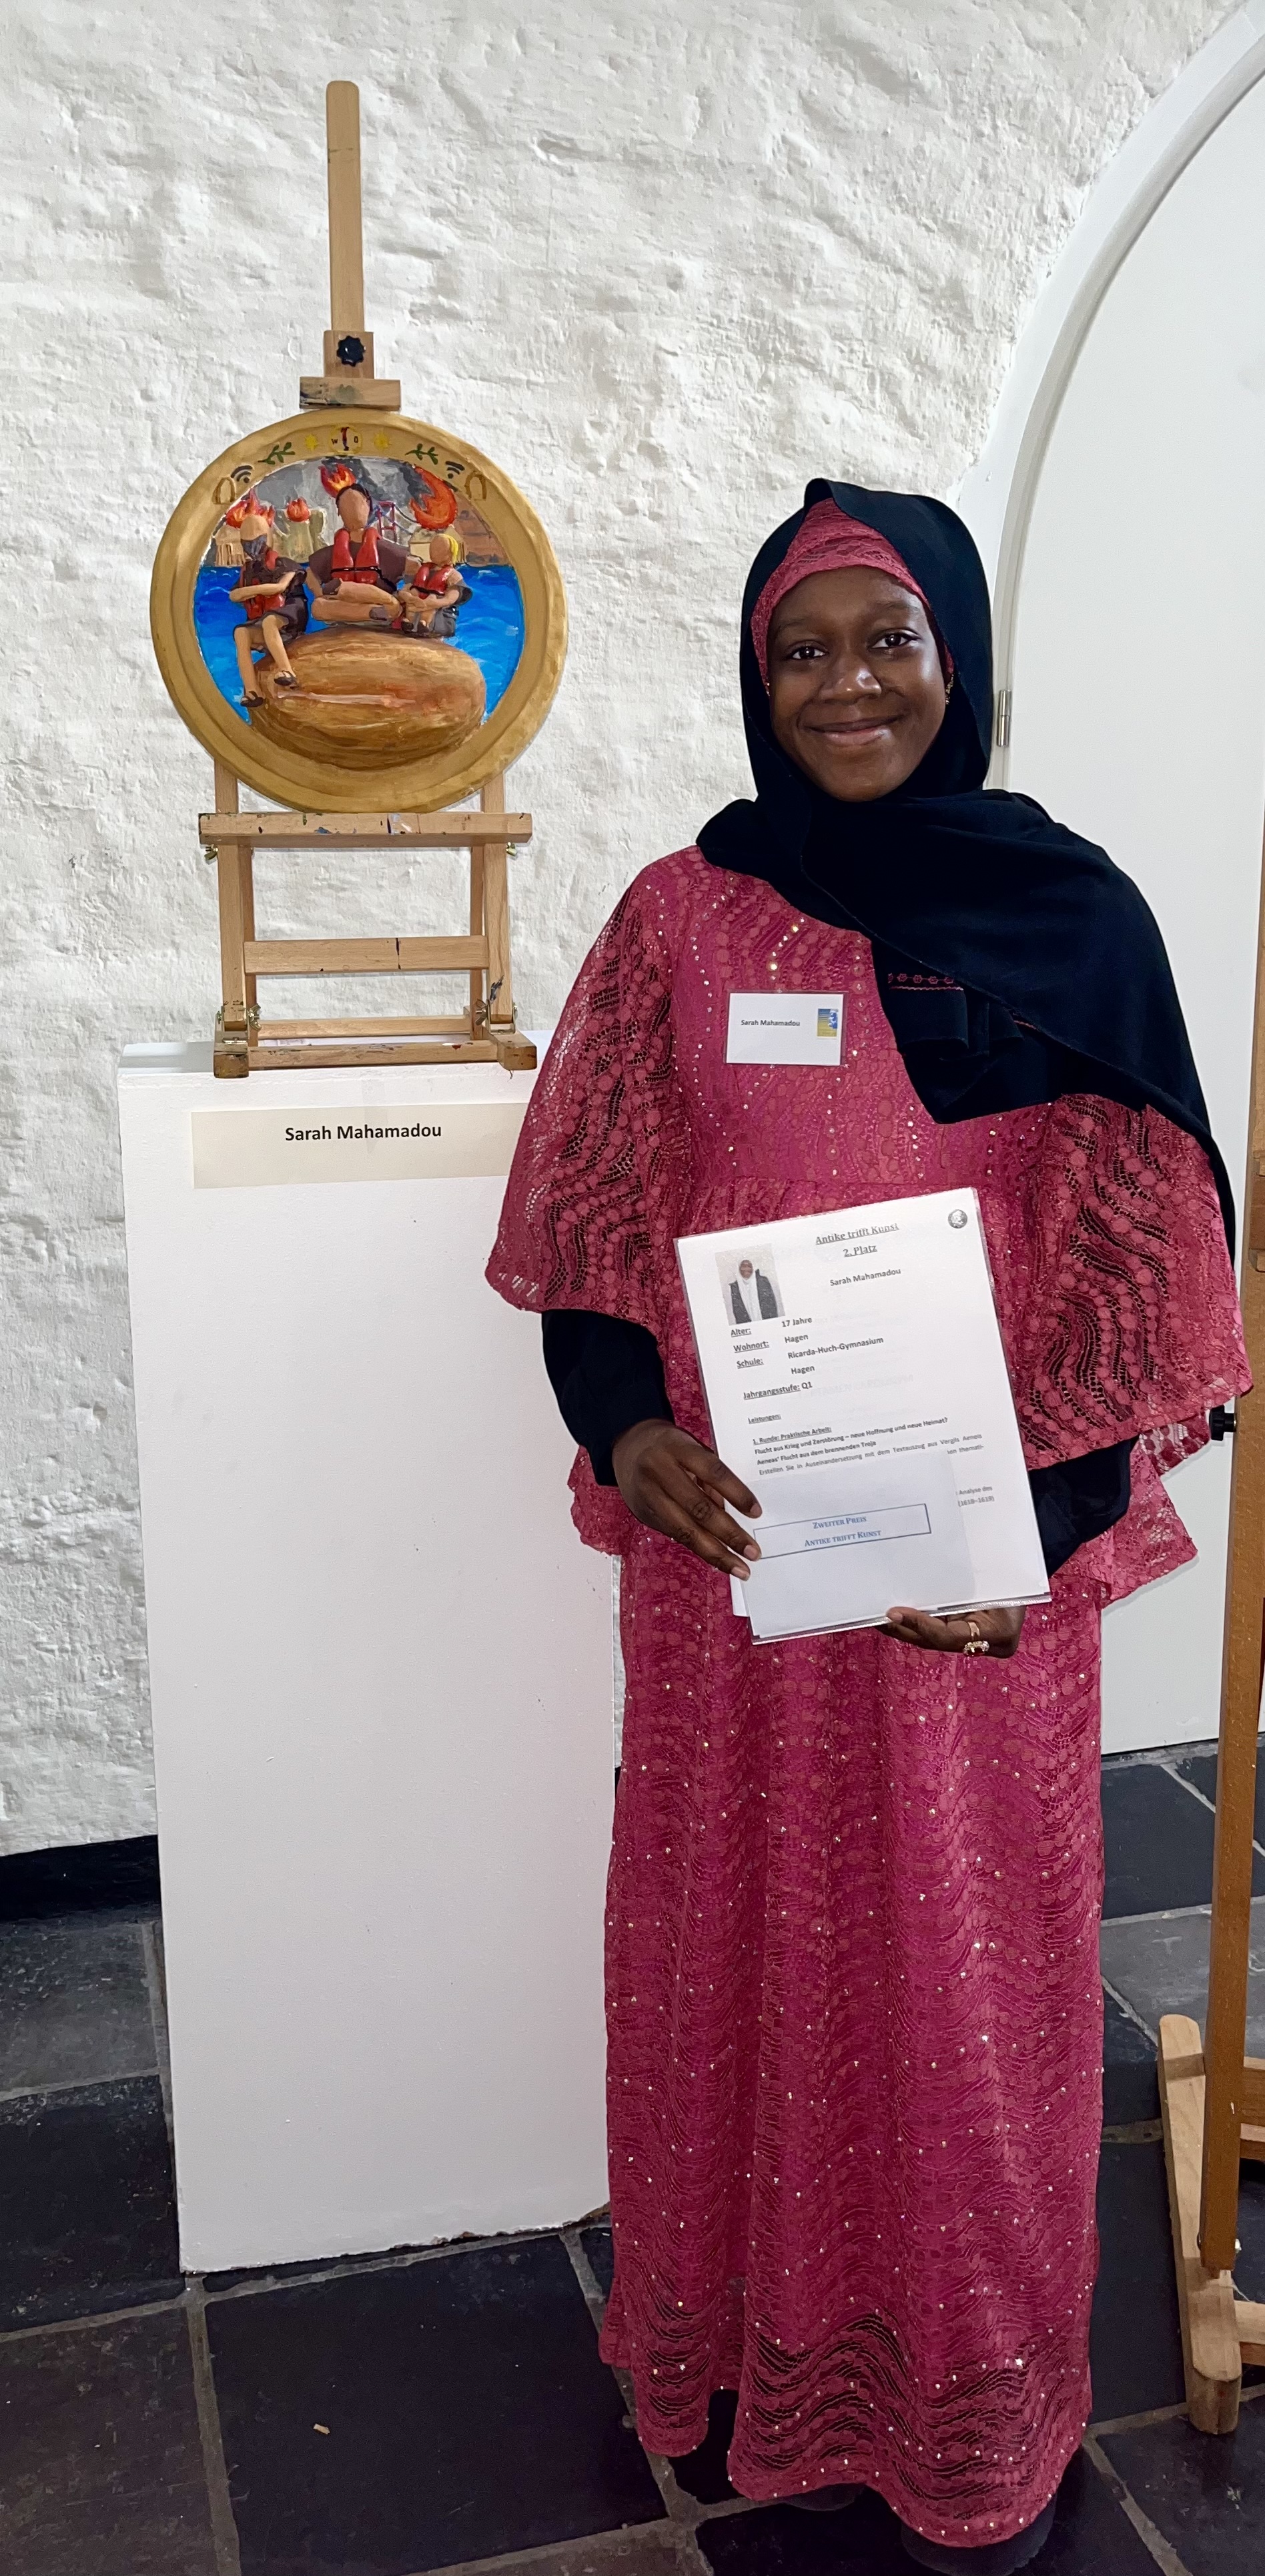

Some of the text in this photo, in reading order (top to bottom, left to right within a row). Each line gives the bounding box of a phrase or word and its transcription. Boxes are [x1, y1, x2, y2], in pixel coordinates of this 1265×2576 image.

[285, 1123, 442, 1141] Sarah Mahamadou
[815, 1223, 899, 1245] Antike trifft Kunst
[843, 1245, 877, 1257] 2. Platz
[830, 1269, 901, 1286] Sarah Mahamadou
[782, 1319, 791, 1327] 17
[792, 1317, 813, 1326] Jahre
[731, 1327, 752, 1337] Alter:
[785, 1334, 809, 1343] Hagen
[733, 1341, 769, 1353] Wohnort:
[787, 1337, 884, 1359] Ricarda-Huch-Gymnasium
[736, 1357, 764, 1369] Schule:
[791, 1365, 815, 1375] Hagen
[743, 1384, 801, 1400] Jahrgangsstufe:
[801, 1381, 813, 1389] Q1
[759, 1435, 780, 1444] Runde:
[780, 1429, 811, 1441] Praktische
[811, 1427, 832, 1436] Arbeit:
[812, 1435, 845, 1445] Zerstörung
[866, 1427, 894, 1435] Hoffnung
[923, 1417, 948, 1426] Heimat?
[824, 1443, 860, 1454] brennenden
[759, 1467, 784, 1476] Erstellen
[805, 1454, 863, 1468] Auseinandersetzung
[892, 1443, 925, 1453] Textauszug
[939, 1437, 960, 1445] Vergils
[959, 1487, 981, 1496] Analyse
